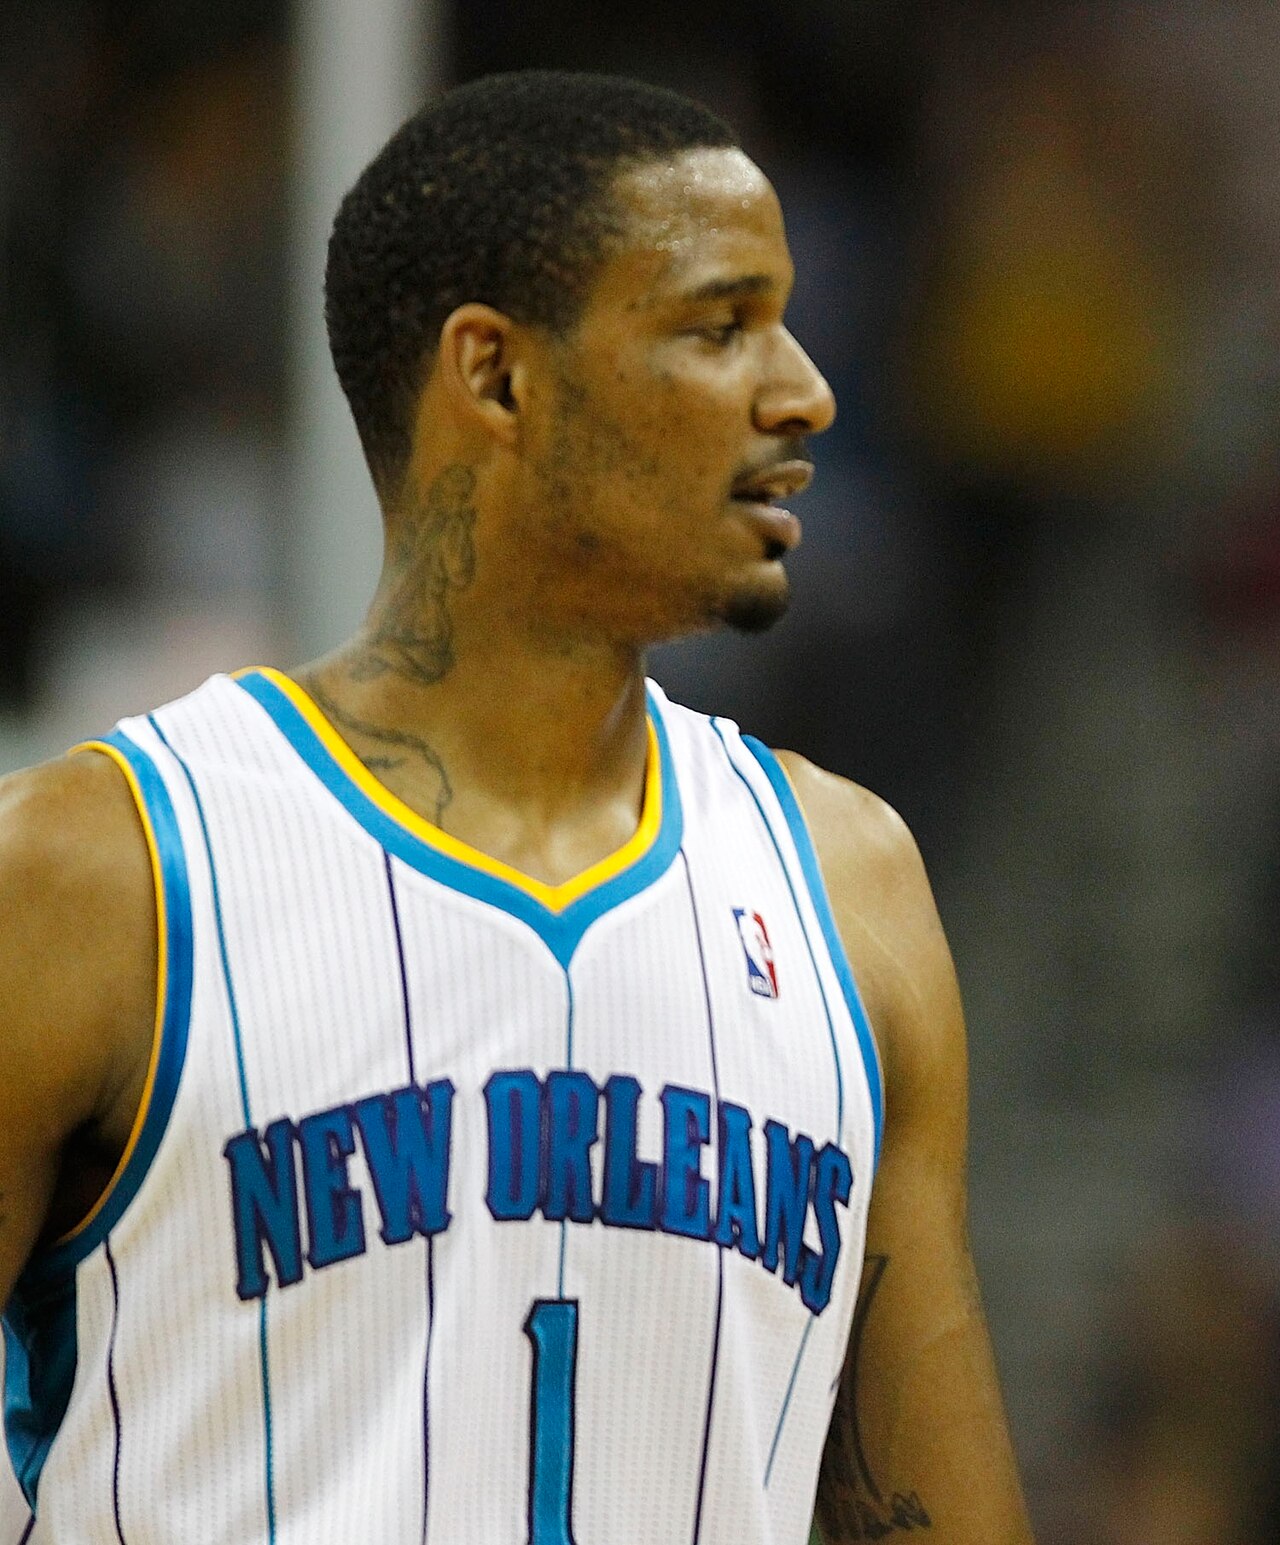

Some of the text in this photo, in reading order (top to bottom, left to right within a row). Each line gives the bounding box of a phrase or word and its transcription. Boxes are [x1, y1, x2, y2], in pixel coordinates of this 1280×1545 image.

[224, 1068, 853, 1316] NEW ORLEANS
[523, 1298, 579, 1545] 1
